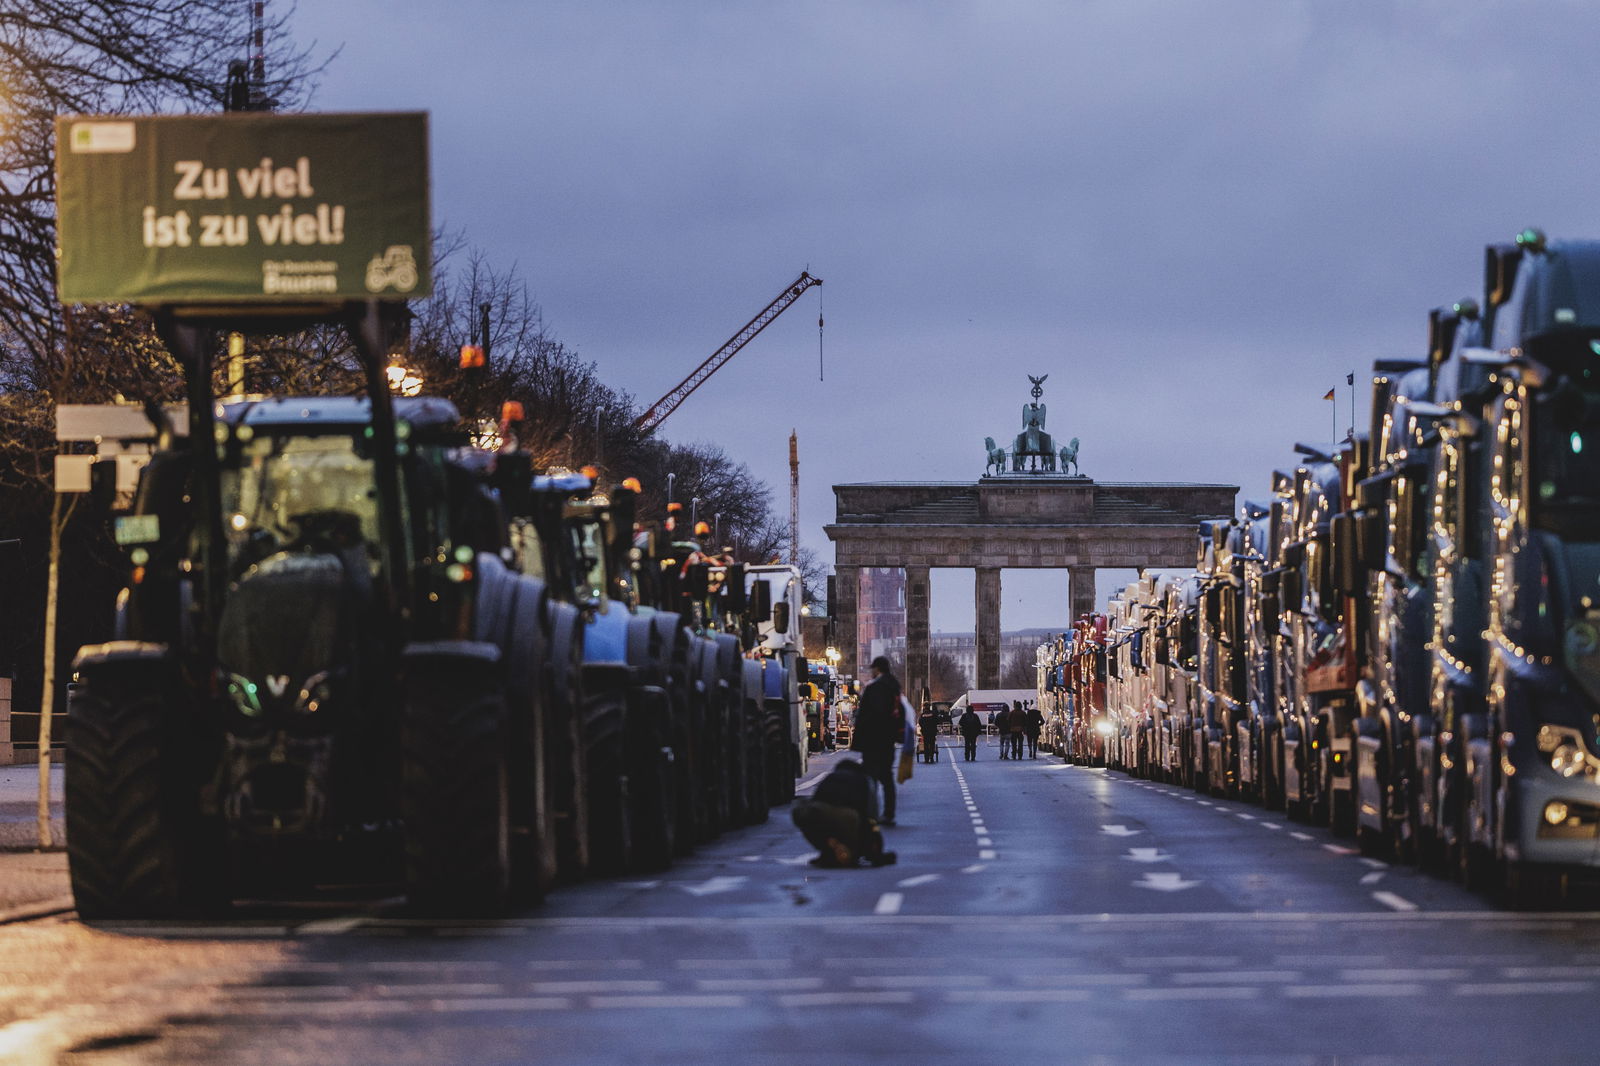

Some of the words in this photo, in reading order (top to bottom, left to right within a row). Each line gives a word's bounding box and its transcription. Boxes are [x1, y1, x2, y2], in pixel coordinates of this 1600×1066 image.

[173, 161, 228, 199] Zu
[236, 157, 314, 199] viel
[142, 205, 191, 248] ist
[199, 214, 249, 247] zu
[256, 204, 345, 246] viel!
